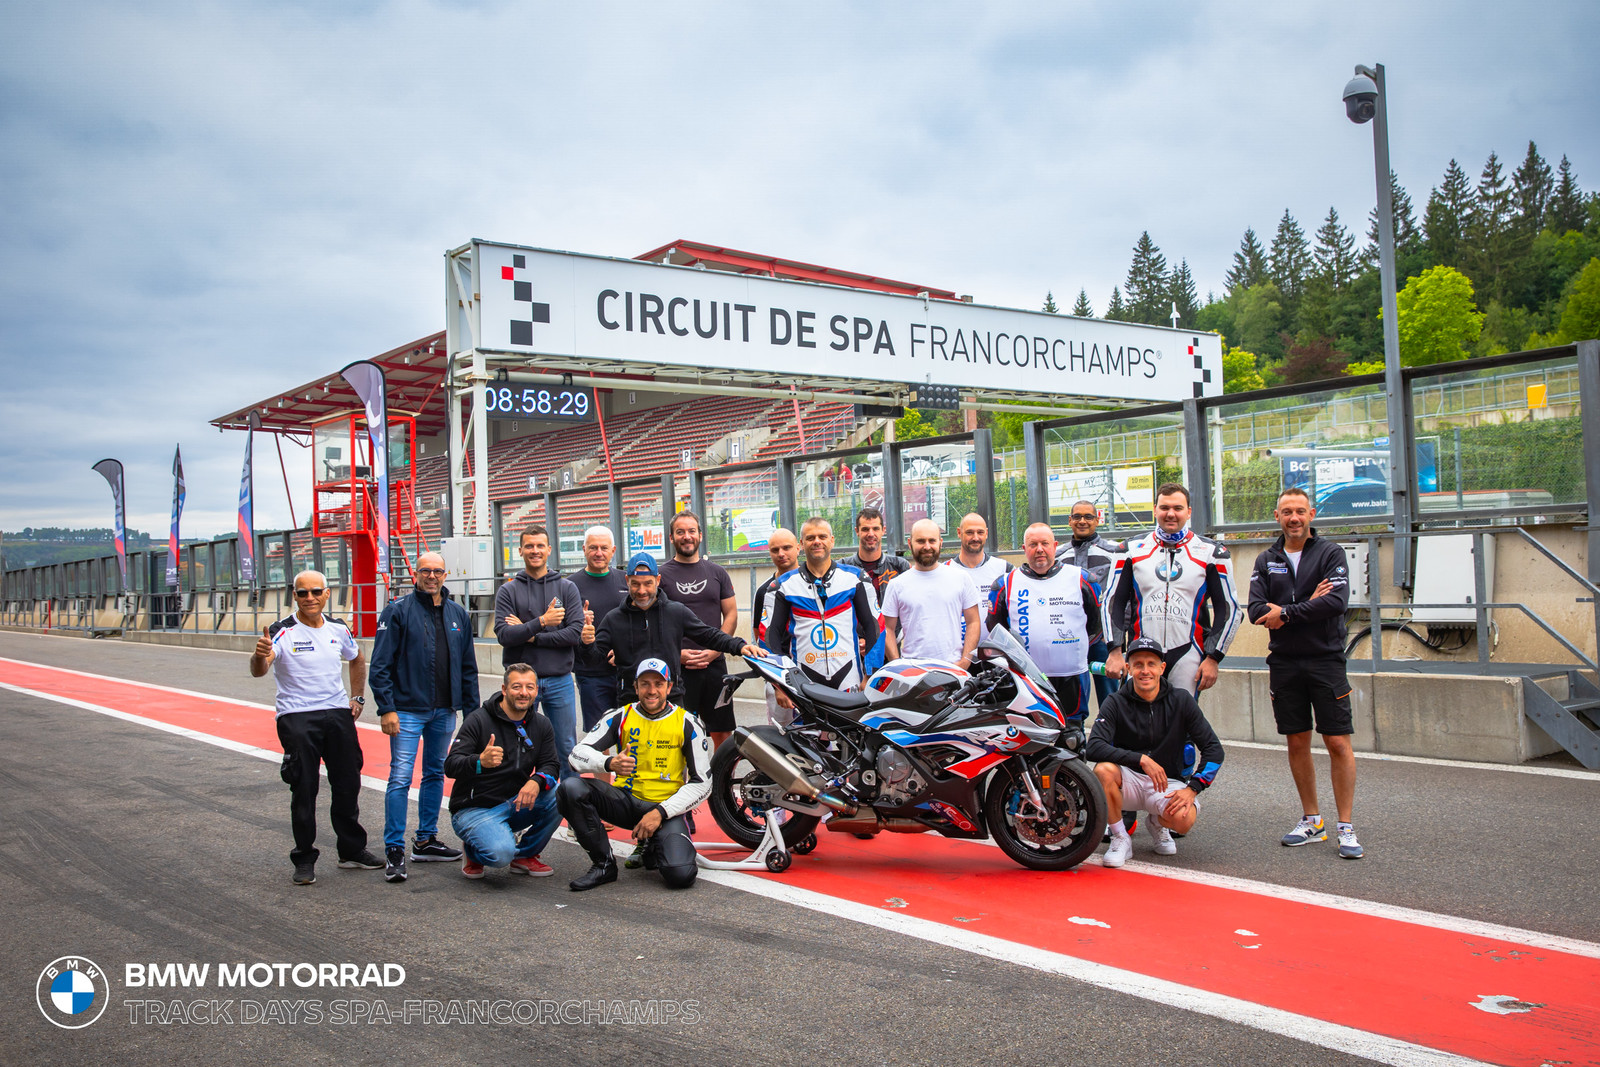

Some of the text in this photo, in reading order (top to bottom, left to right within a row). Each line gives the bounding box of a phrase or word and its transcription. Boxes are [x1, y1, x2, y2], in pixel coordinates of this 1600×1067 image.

[597, 288, 756, 343] CIRCUIT
[769, 307, 817, 349] DE
[829, 314, 896, 356] SPA
[485, 387, 589, 416] 08:58:29
[630, 529, 663, 550] BigMat
